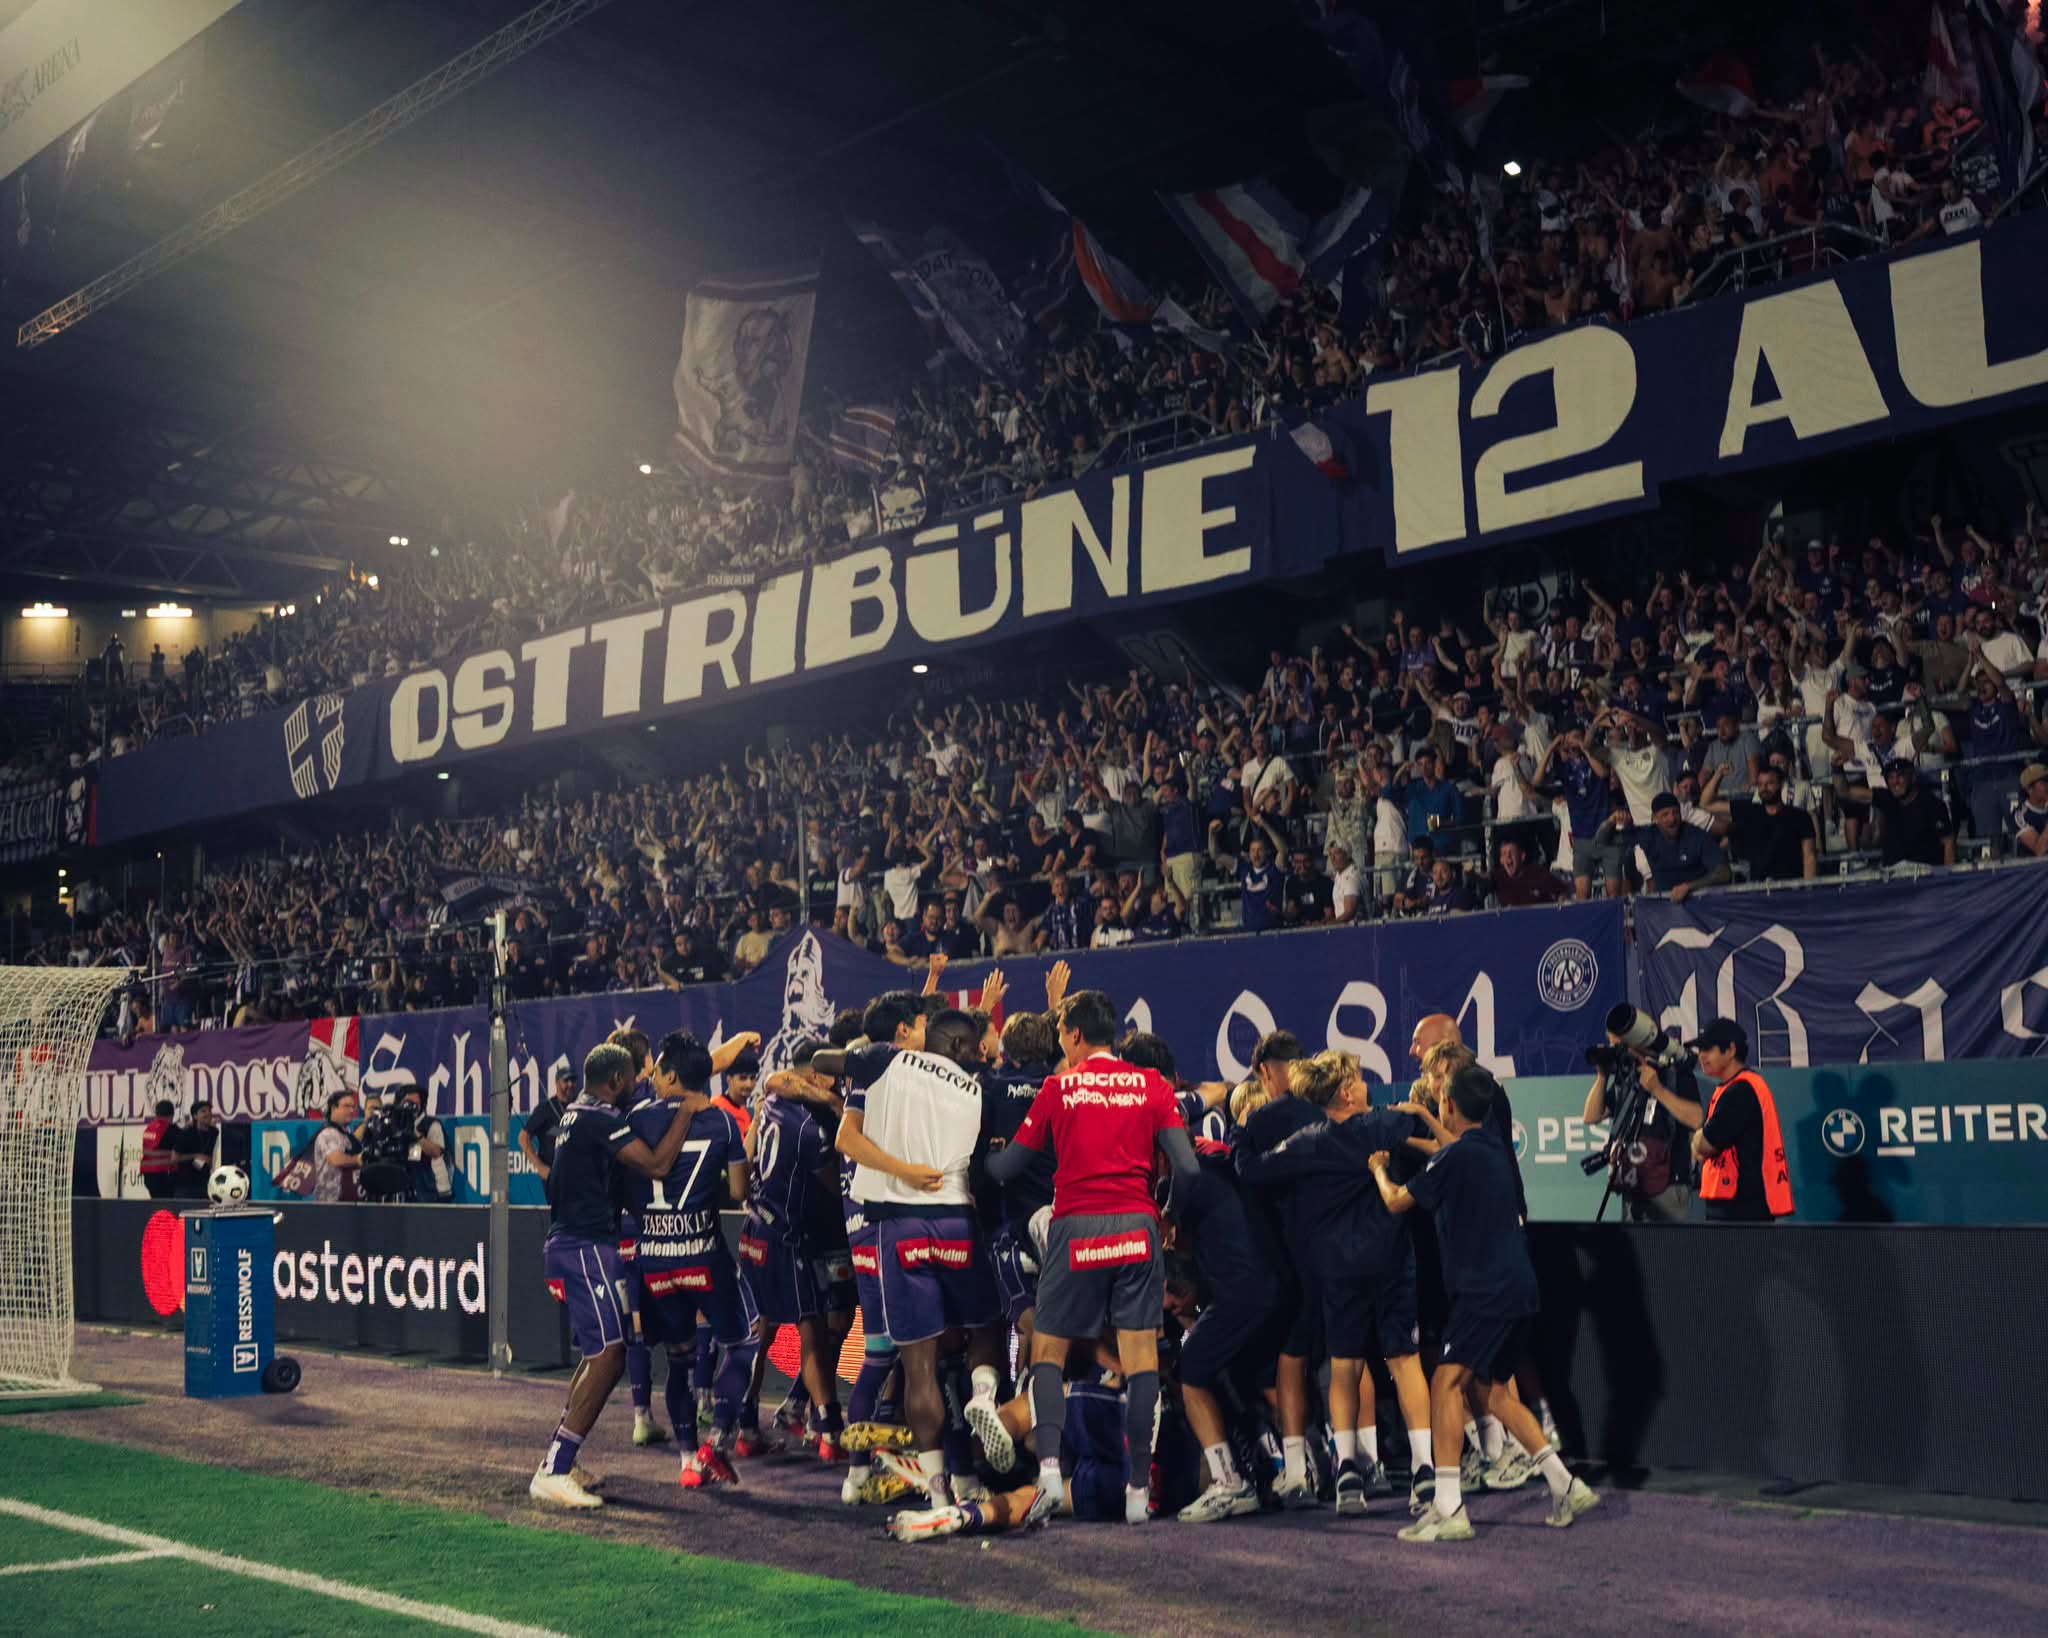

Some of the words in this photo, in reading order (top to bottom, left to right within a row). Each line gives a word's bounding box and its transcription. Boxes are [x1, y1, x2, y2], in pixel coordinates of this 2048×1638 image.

[390, 445, 1256, 764] OSTTRIBÜNE
[1366, 324, 1645, 553] 12
[80, 1067, 147, 1125] ULL
[189, 1055, 292, 1121] DOGS
[901, 1052, 979, 1096] macron
[1060, 1071, 1147, 1091] macron
[1880, 1103, 2048, 1143] REITER
[642, 1213, 695, 1237] TAESEOK
[1075, 1240, 1148, 1264] wienholding
[237, 1247, 253, 1342] REISSWOLF
[272, 1239, 487, 1315] astercard
